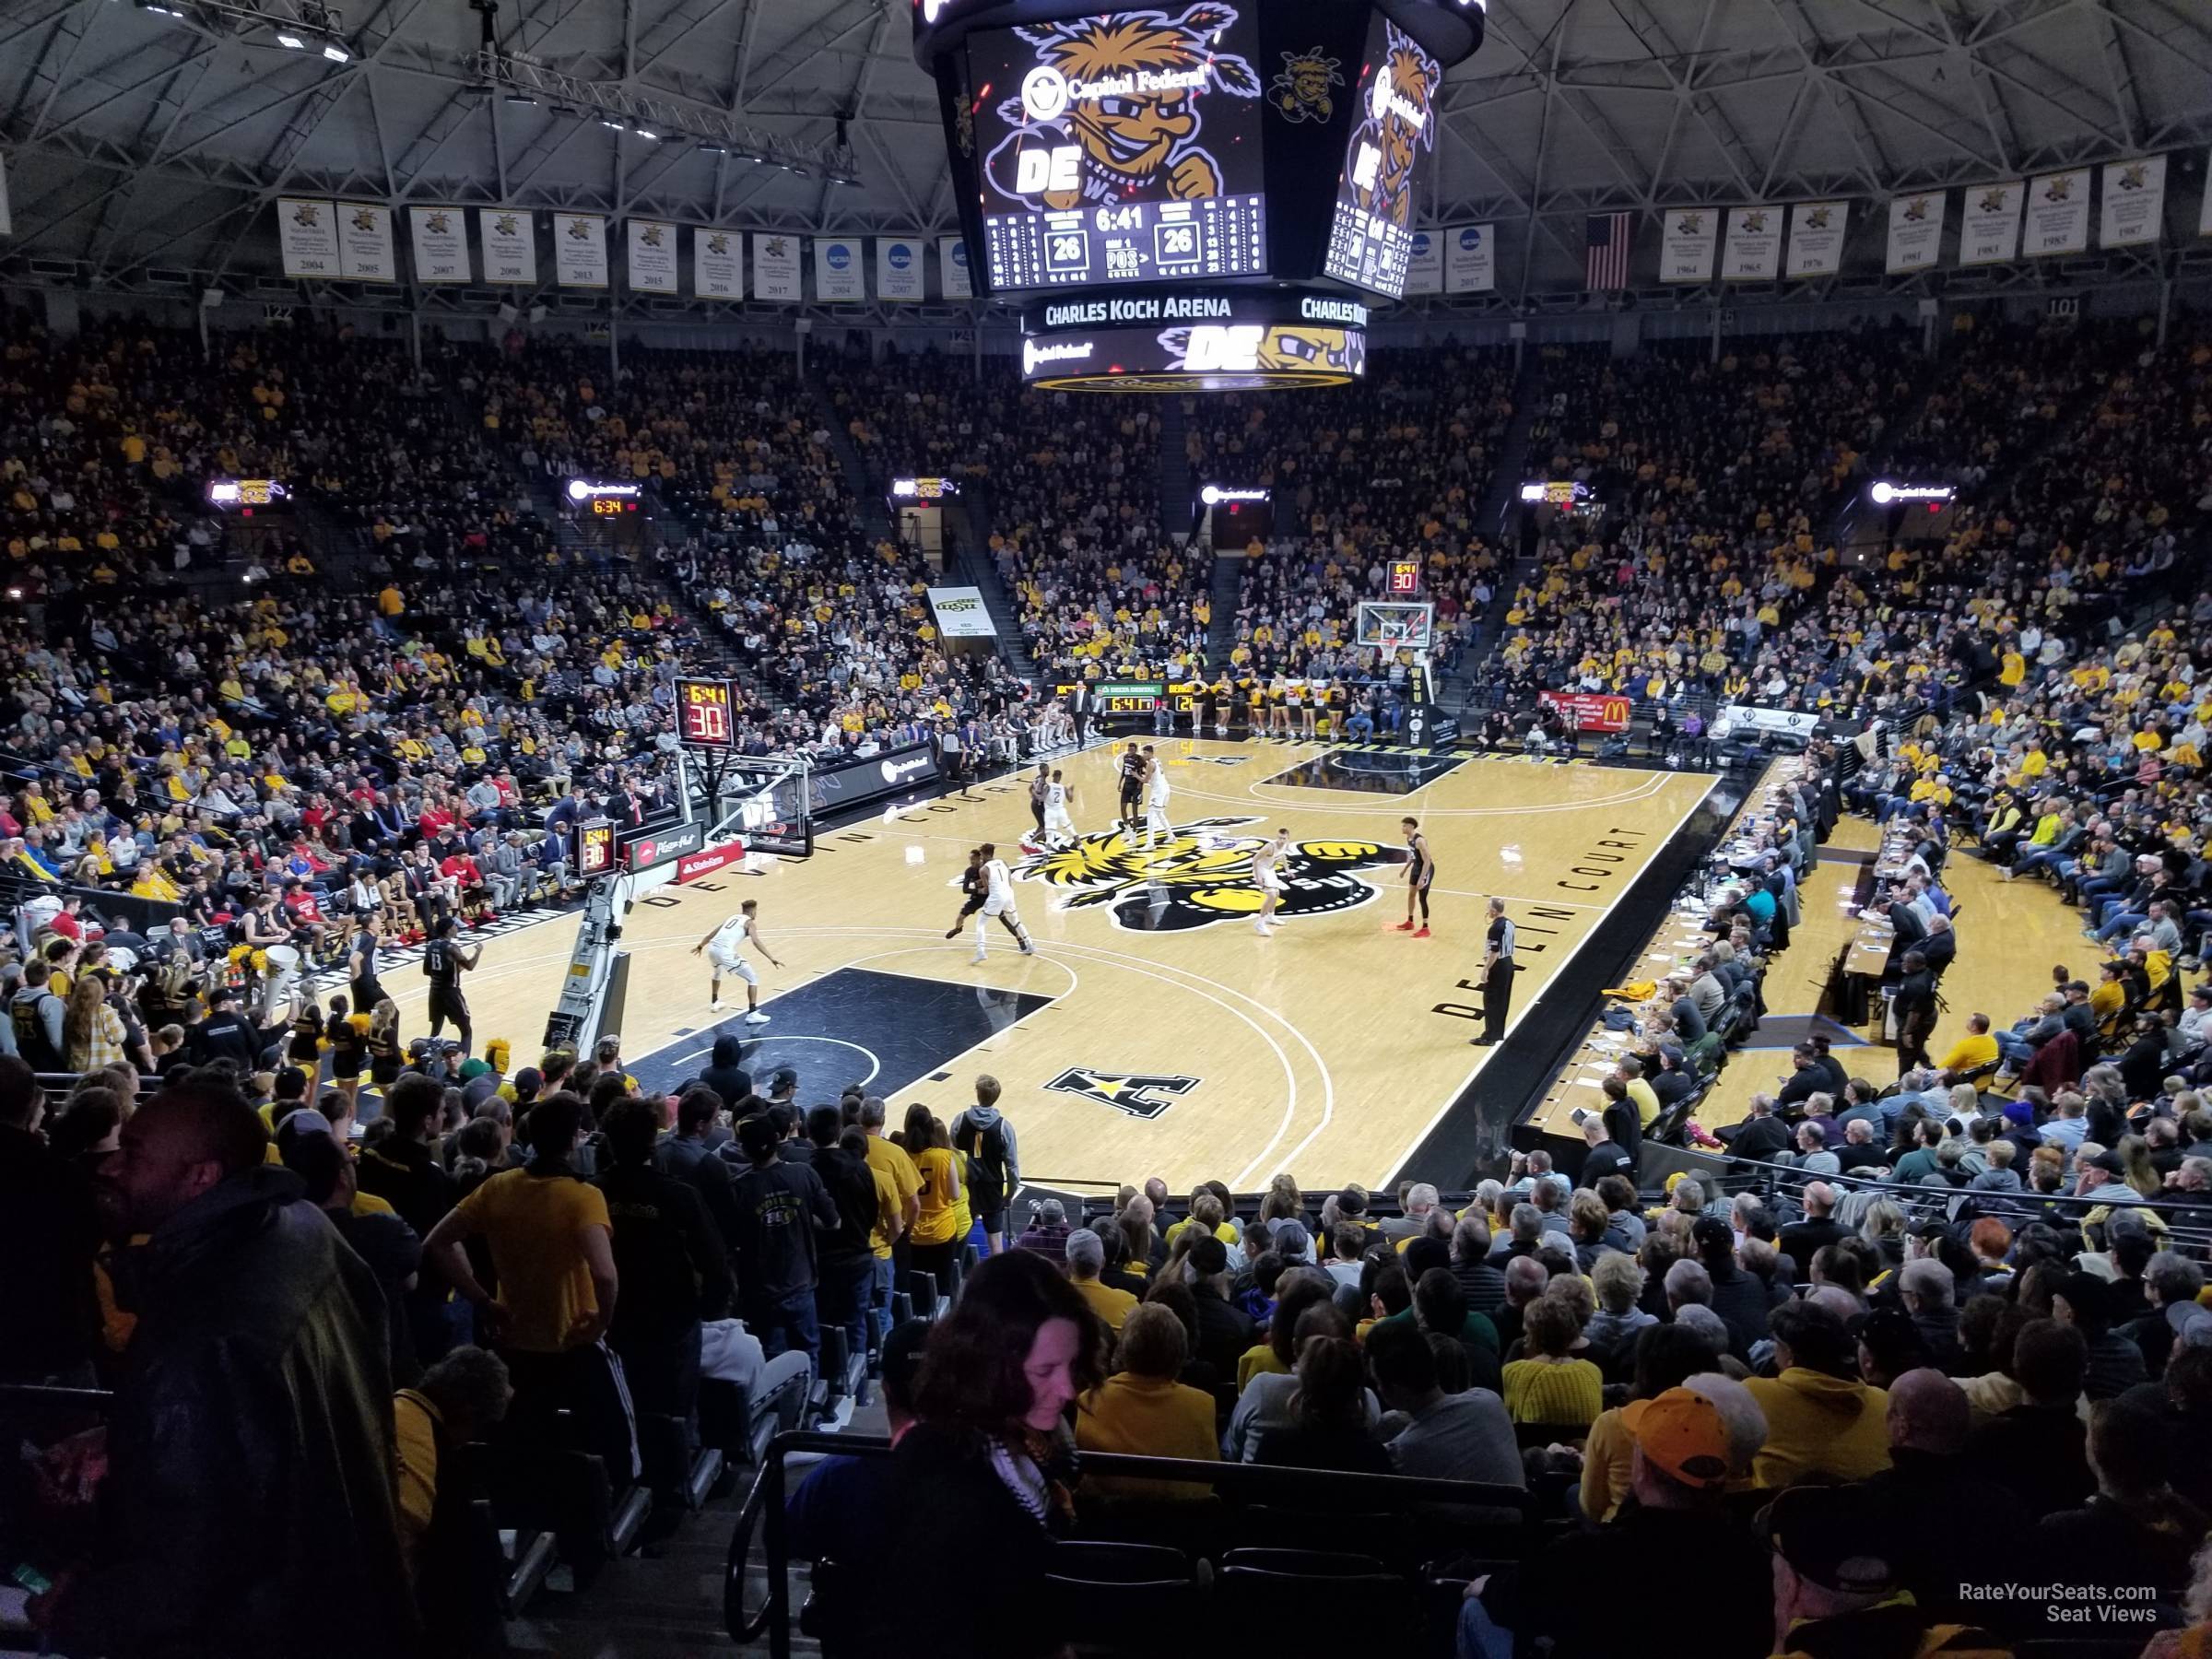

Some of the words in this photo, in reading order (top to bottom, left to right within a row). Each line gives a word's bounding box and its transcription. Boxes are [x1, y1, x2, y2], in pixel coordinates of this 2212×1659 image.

[1067, 74, 1134, 100] Capitol
[1136, 65, 1206, 91] Federal
[1096, 206, 1142, 232] 6:41
[1053, 236, 1081, 261] 26
[1164, 229, 1193, 253] 26
[1046, 302, 1107, 325] CHARLES
[1110, 300, 1159, 321] KOCH
[1162, 298, 1231, 318] ARENA
[1301, 298, 1353, 322] CHARLES
[594, 500, 621, 513] 6:34
[1394, 573, 1412, 588] 30
[689, 685, 726, 704] 6:41
[1112, 697, 1142, 711] 6:41
[689, 704, 724, 737] 30
[586, 845, 605, 866] 30
[1557, 828, 1646, 891] COURT
[430, 952, 441, 970] 13
